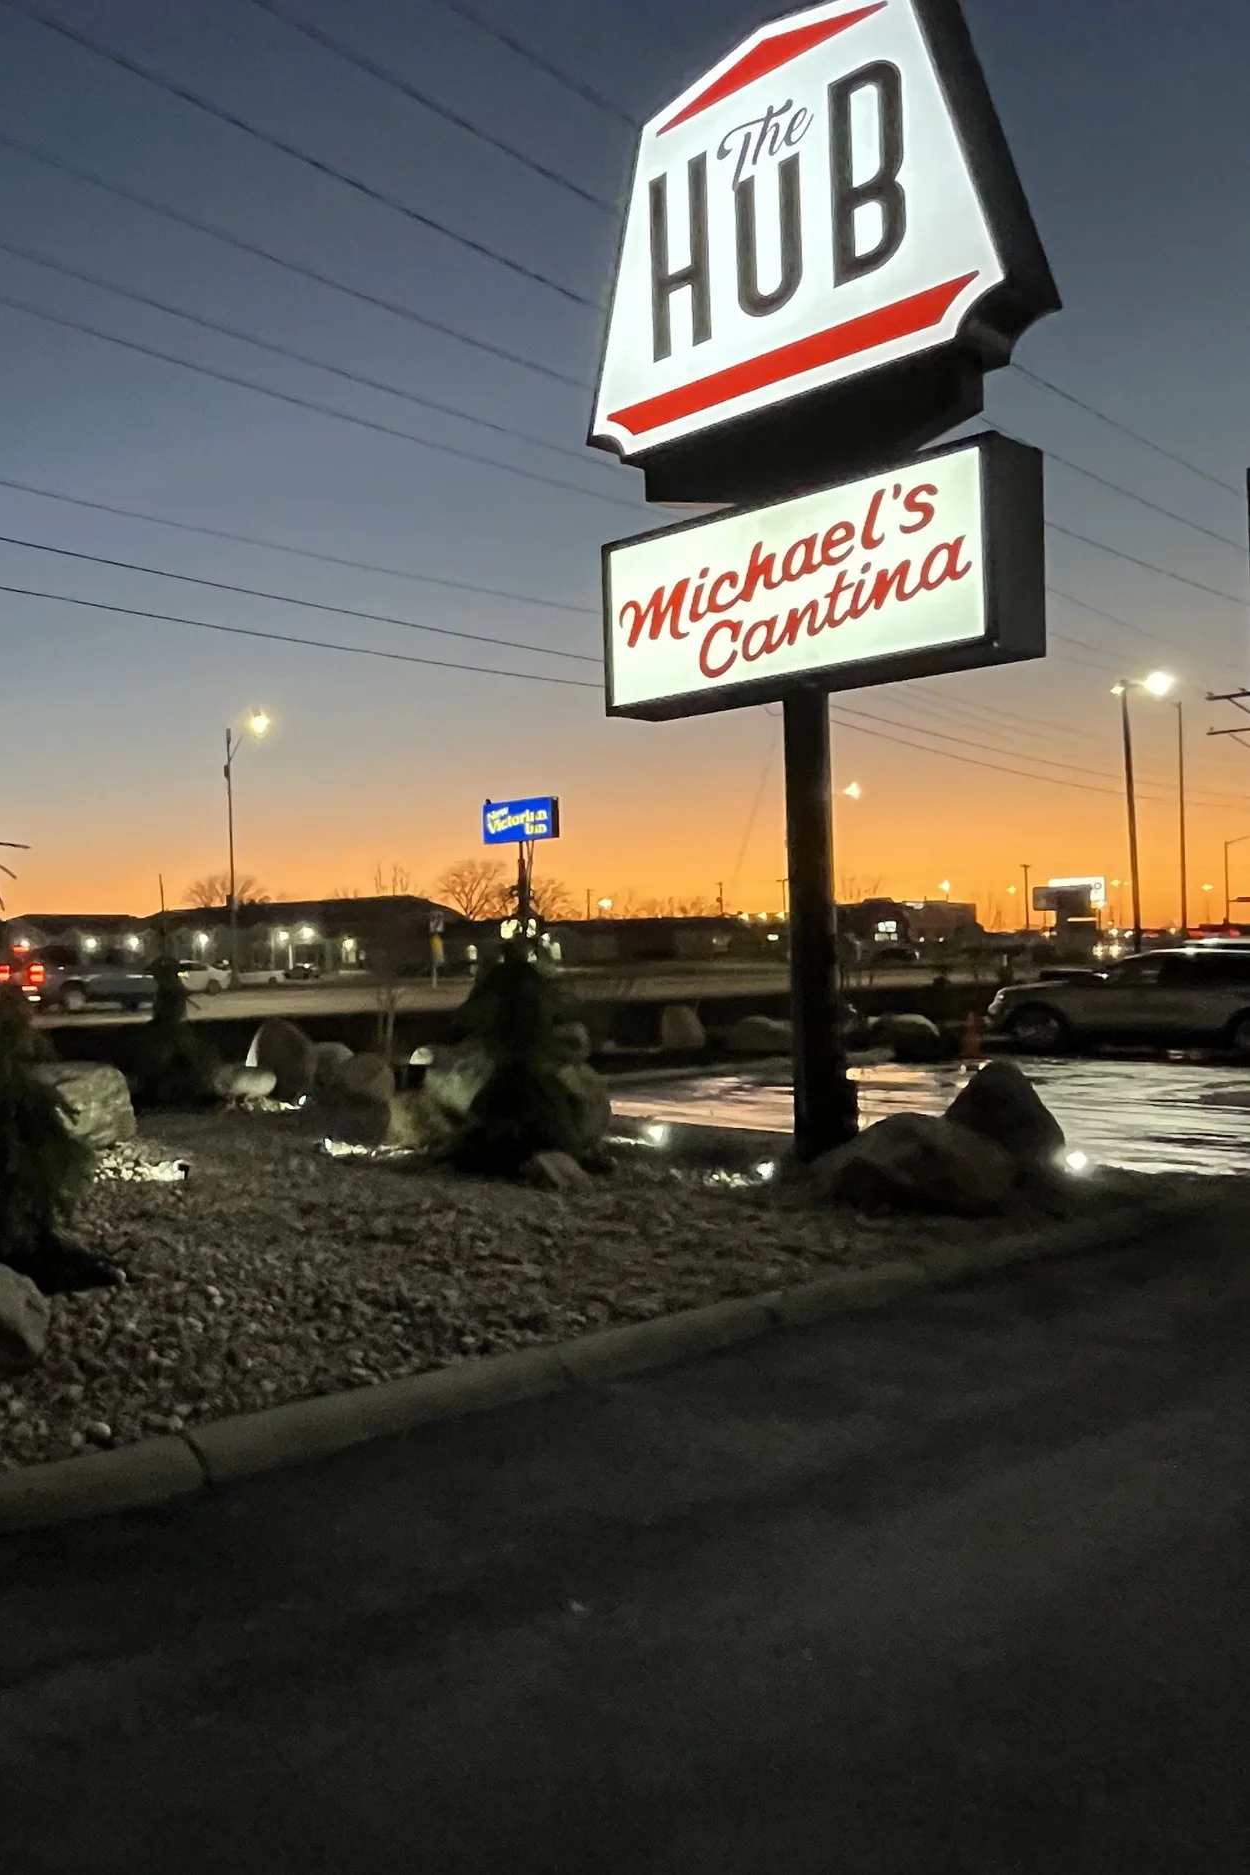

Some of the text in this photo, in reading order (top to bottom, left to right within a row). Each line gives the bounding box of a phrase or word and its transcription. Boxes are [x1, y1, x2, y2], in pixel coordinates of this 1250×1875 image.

[648, 59, 907, 363] HUB
[717, 99, 814, 191] The
[619, 482, 940, 648] Michael's
[698, 535, 972, 678] Cantina
